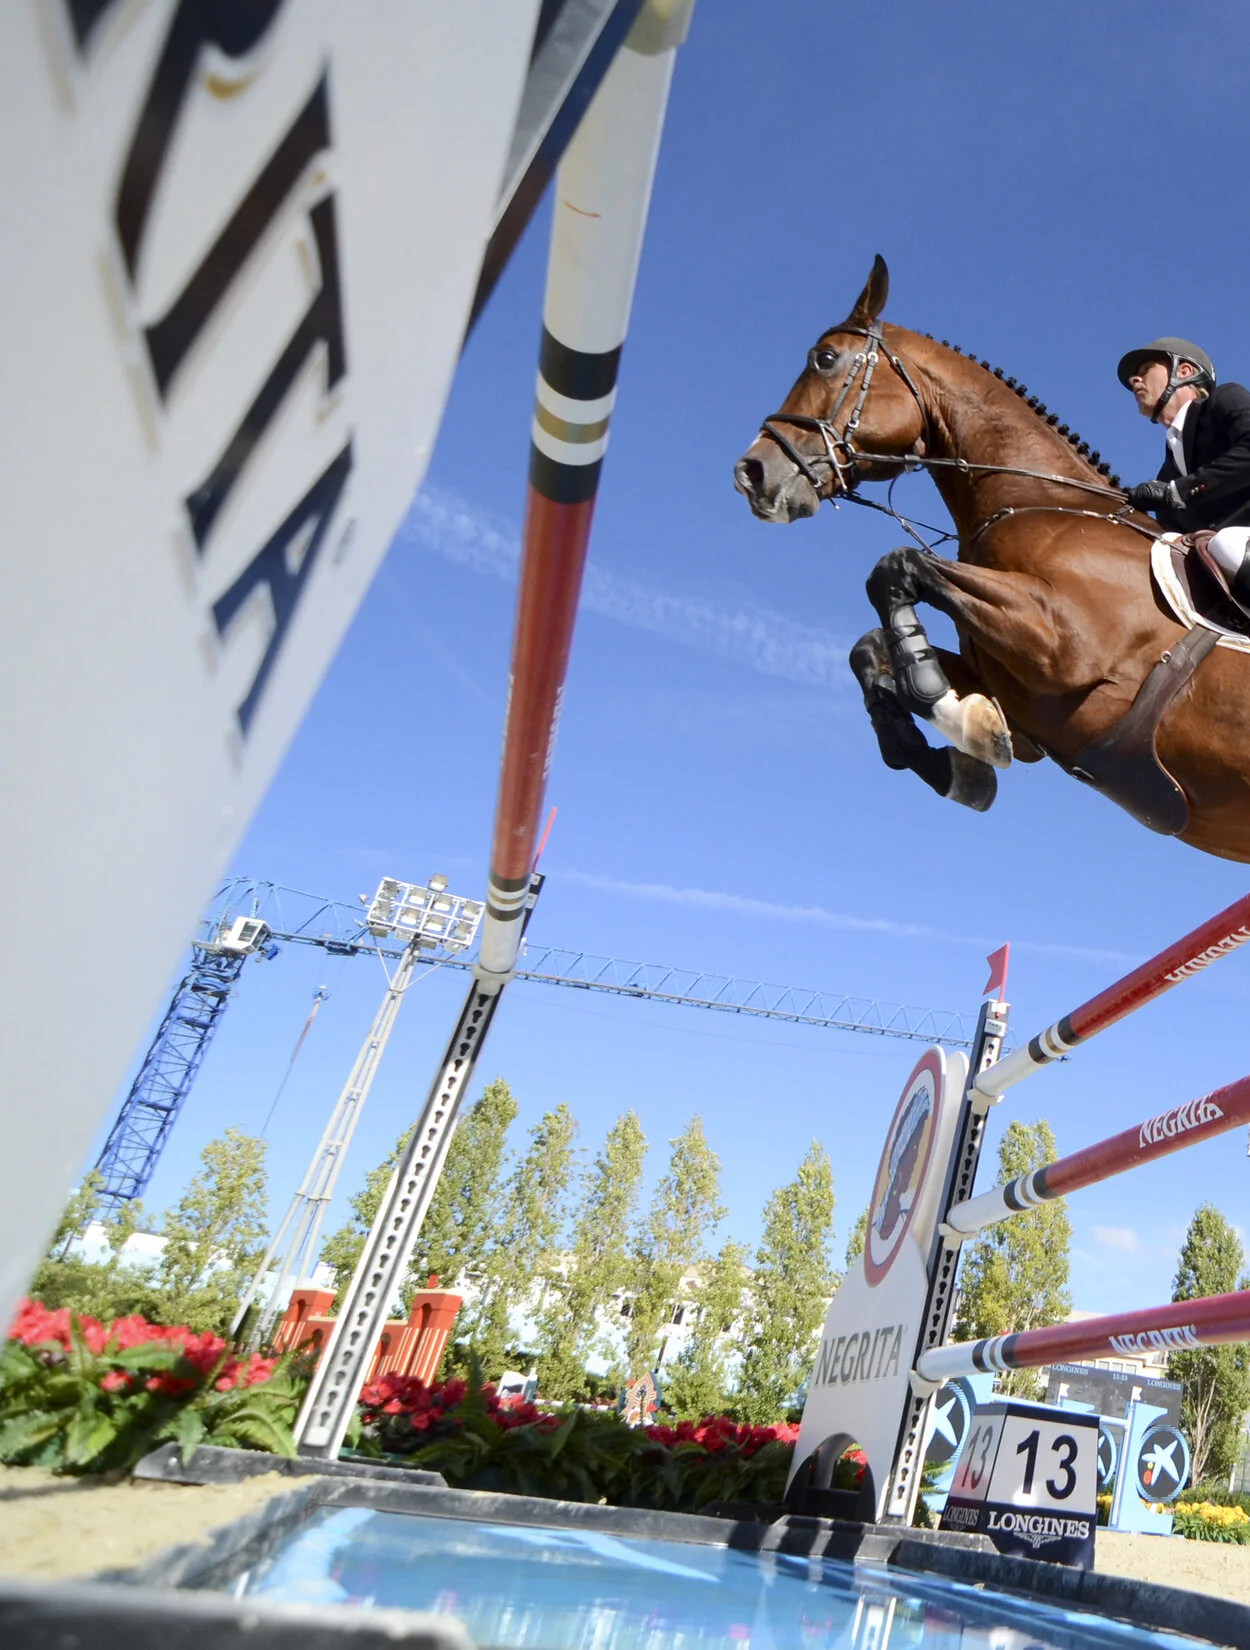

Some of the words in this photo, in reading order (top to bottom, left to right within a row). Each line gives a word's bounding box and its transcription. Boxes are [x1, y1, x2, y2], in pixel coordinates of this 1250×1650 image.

[1139, 1092, 1224, 1149] NEGRITA
[815, 1324, 903, 1386] NEGRITA
[1052, 1364, 1089, 1376] LONGINES
[1147, 1378, 1182, 1391] LONGINES
[961, 1425, 993, 1490] 13
[1016, 1430, 1078, 1500] 13
[943, 1505, 980, 1527] LONGINES
[987, 1511, 1090, 1539] LONGINES
